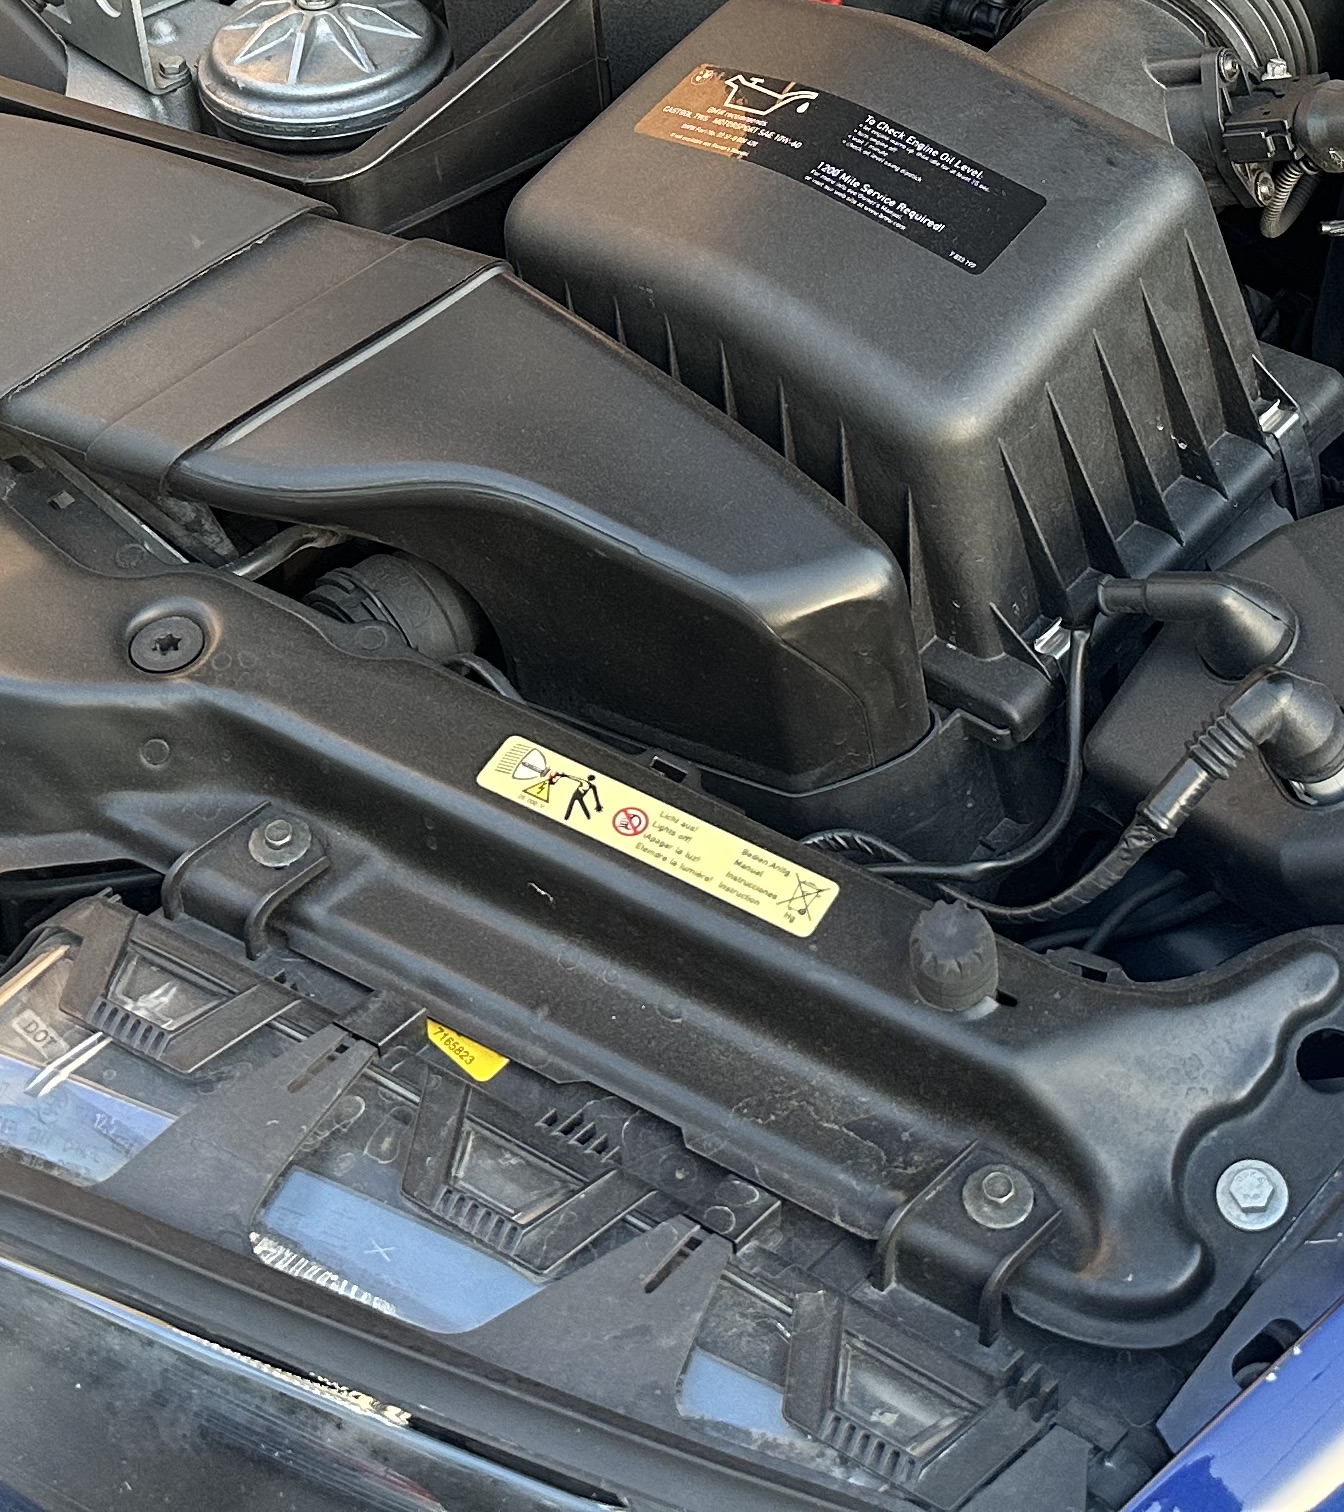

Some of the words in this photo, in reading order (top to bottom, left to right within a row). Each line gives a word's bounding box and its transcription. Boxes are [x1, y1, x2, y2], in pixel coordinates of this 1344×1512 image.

[758, 128, 775, 139] SAE
[774, 133, 803, 149] 10W-60
[865, 115, 876, 125] To
[877, 122, 906, 140] Check
[906, 136, 939, 156] Engine
[940, 152, 956, 164] Oil
[870, 138, 889, 149] engine
[820, 174, 836, 185] more
[816, 162, 841, 177] 1200
[839, 173, 860, 188] Mile
[860, 183, 896, 207] Service
[896, 202, 946, 232] Required!
[833, 190, 846, 199] web
[652, 820, 676, 836] Lights
[660, 811, 680, 824] Licht
[681, 822, 699, 832] aus!
[669, 858, 677, 866] la
[734, 859, 764, 877] Manual
[718, 881, 760, 906] Instruction
[725, 871, 778, 900] Instrucciones
[783, 912, 795, 923] Hg
[22, 1019, 57, 1052] DOT
